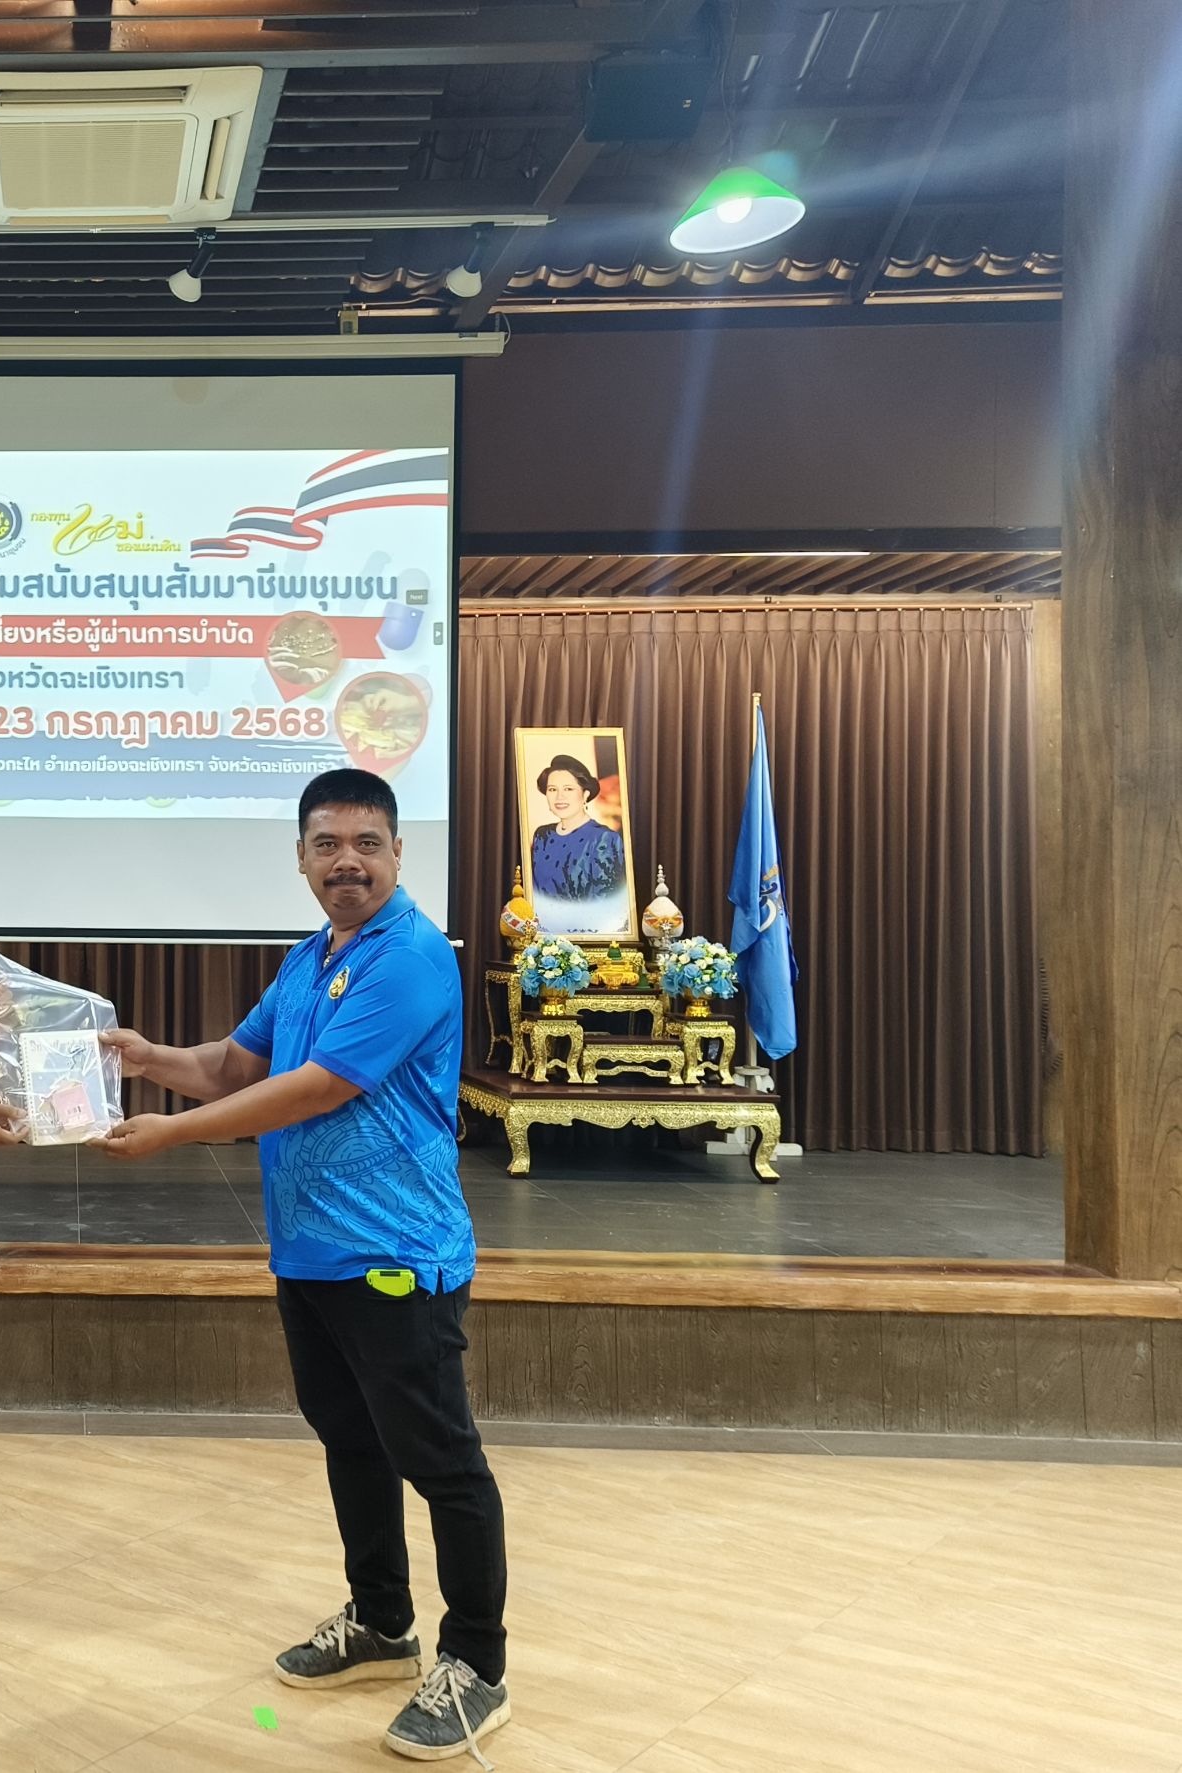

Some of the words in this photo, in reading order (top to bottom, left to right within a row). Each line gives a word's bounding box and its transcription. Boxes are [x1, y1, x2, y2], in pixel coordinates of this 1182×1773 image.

[45, 709, 218, 746] กรกฎาคม
[230, 707, 327, 738] 2568
[44, 754, 204, 772] อำเภอเมืองฉะเชิงเทรา
